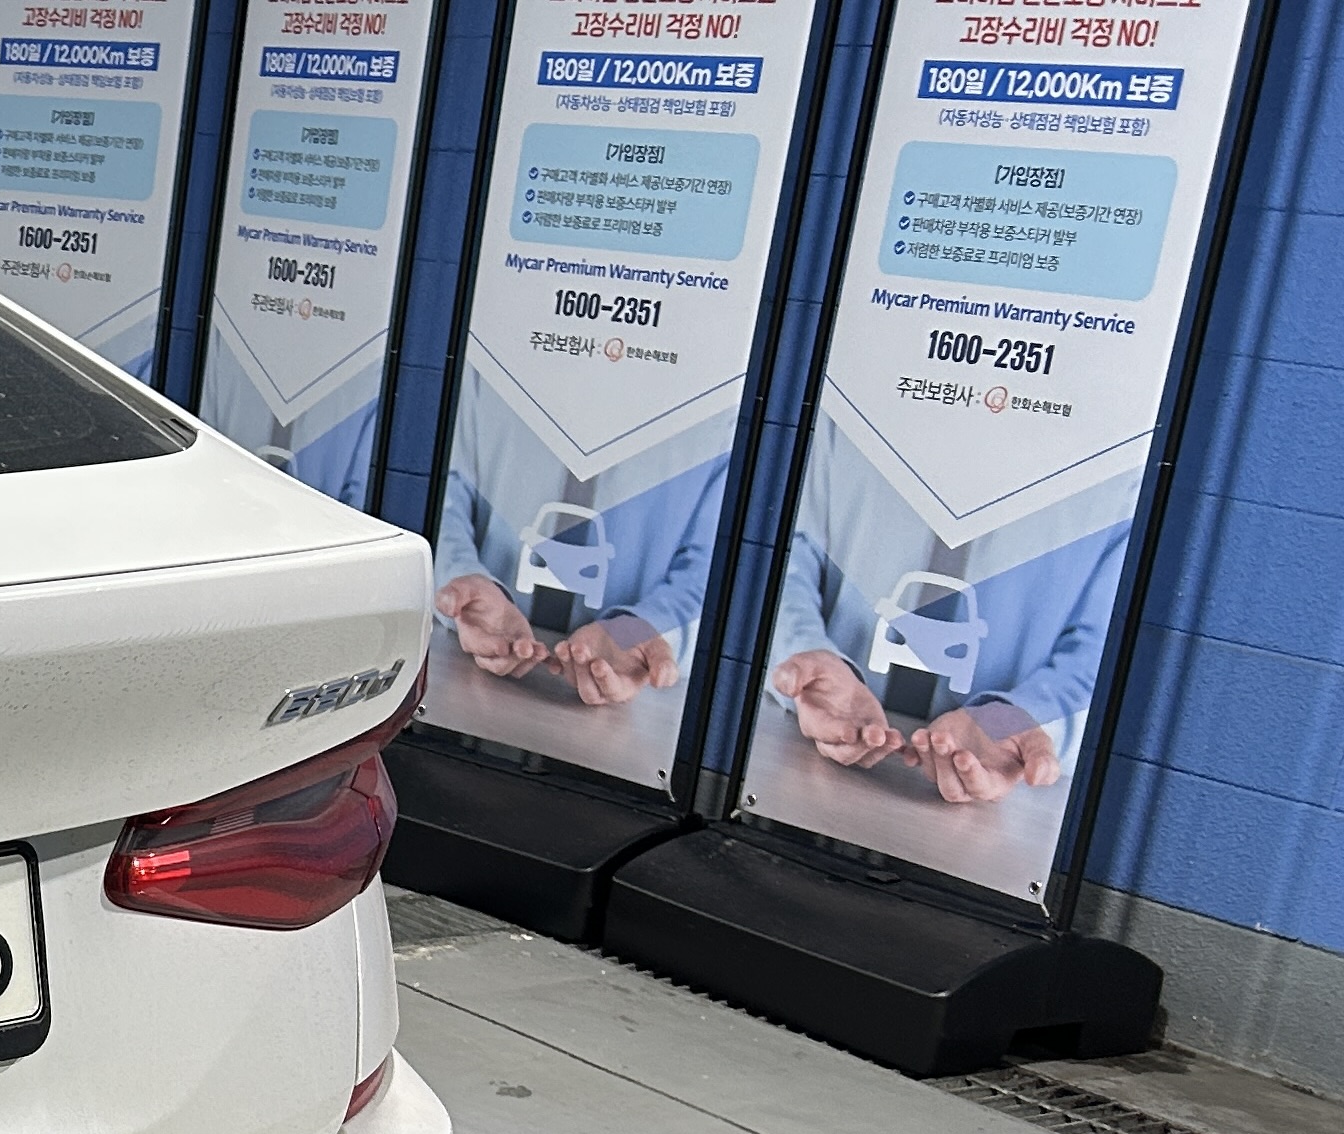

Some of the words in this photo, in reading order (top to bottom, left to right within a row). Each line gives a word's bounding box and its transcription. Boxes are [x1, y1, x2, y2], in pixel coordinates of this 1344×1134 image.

[22, 7, 87, 28] 고장수리비
[90, 9, 116, 29] 걱정
[118, 10, 143, 29] NO!
[281, 12, 337, 35] 고장수리비
[340, 13, 363, 36] 걱정
[363, 13, 386, 35] NO!
[571, 12, 662, 38] 고장수리비
[666, 14, 703, 39] 걱정
[705, 15, 741, 38] NO!
[959, 16, 1067, 46] 고장수리비
[1071, 18, 1114, 47] 걱정
[1117, 20, 1159, 47] NO!
[5, 43, 41, 62] 180일
[54, 45, 124, 65] 12,000Km
[126, 48, 154, 66] 보증
[266, 53, 296, 73] 180일
[307, 54, 368, 76] 12,000Km
[369, 56, 394, 77] 보증
[547, 58, 595, 81] 180일
[614, 60, 711, 85] 12,000Km
[714, 64, 755, 87] 보증
[929, 68, 986, 94] 180일
[1007, 71, 1122, 100] 12,000Km
[1126, 75, 1174, 103] 보증
[707, 101, 736, 117] 포함)
[1063, 114, 1117, 135] 책임보험
[1116, 118, 1150, 136] 포함)
[606, 143, 665, 164] [가입장점]
[609, 172, 639, 188] 서비스
[995, 165, 1065, 189] [가입장점]
[11, 201, 56, 216] Premium
[58, 205, 106, 224] Warranty
[107, 209, 145, 224] Service
[605, 196, 655, 213] 보증스티커
[917, 192, 961, 210] 구매고객
[962, 196, 996, 213] 차별화
[997, 199, 1033, 215] 서비스
[1035, 201, 1112, 223] 제공(보증기간
[1113, 208, 1143, 225] 연장)
[19, 226, 98, 254] 1600-2351
[642, 222, 663, 237] 보증
[912, 217, 957, 236] 판매차량
[957, 221, 991, 239] 부착용
[991, 224, 1051, 244] 보증스티커
[1053, 229, 1077, 246] 발부
[344, 239, 377, 256] Service
[907, 242, 940, 259] 저렴한
[940, 246, 986, 263] 보증료로
[987, 251, 1034, 269] 프리미엄
[1034, 255, 1060, 272] 보증
[268, 256, 336, 289] 1600-2351
[505, 253, 545, 273] Mycar
[546, 258, 606, 277] Premium
[610, 264, 675, 289] Warranty
[676, 271, 728, 290] Service
[555, 290, 661, 327] 1600-2351
[871, 288, 918, 310] Mycar
[919, 294, 990, 317] Premium
[994, 302, 1072, 331] Warranty
[1073, 311, 1135, 334] Service
[928, 330, 1055, 375] 1600-2351
